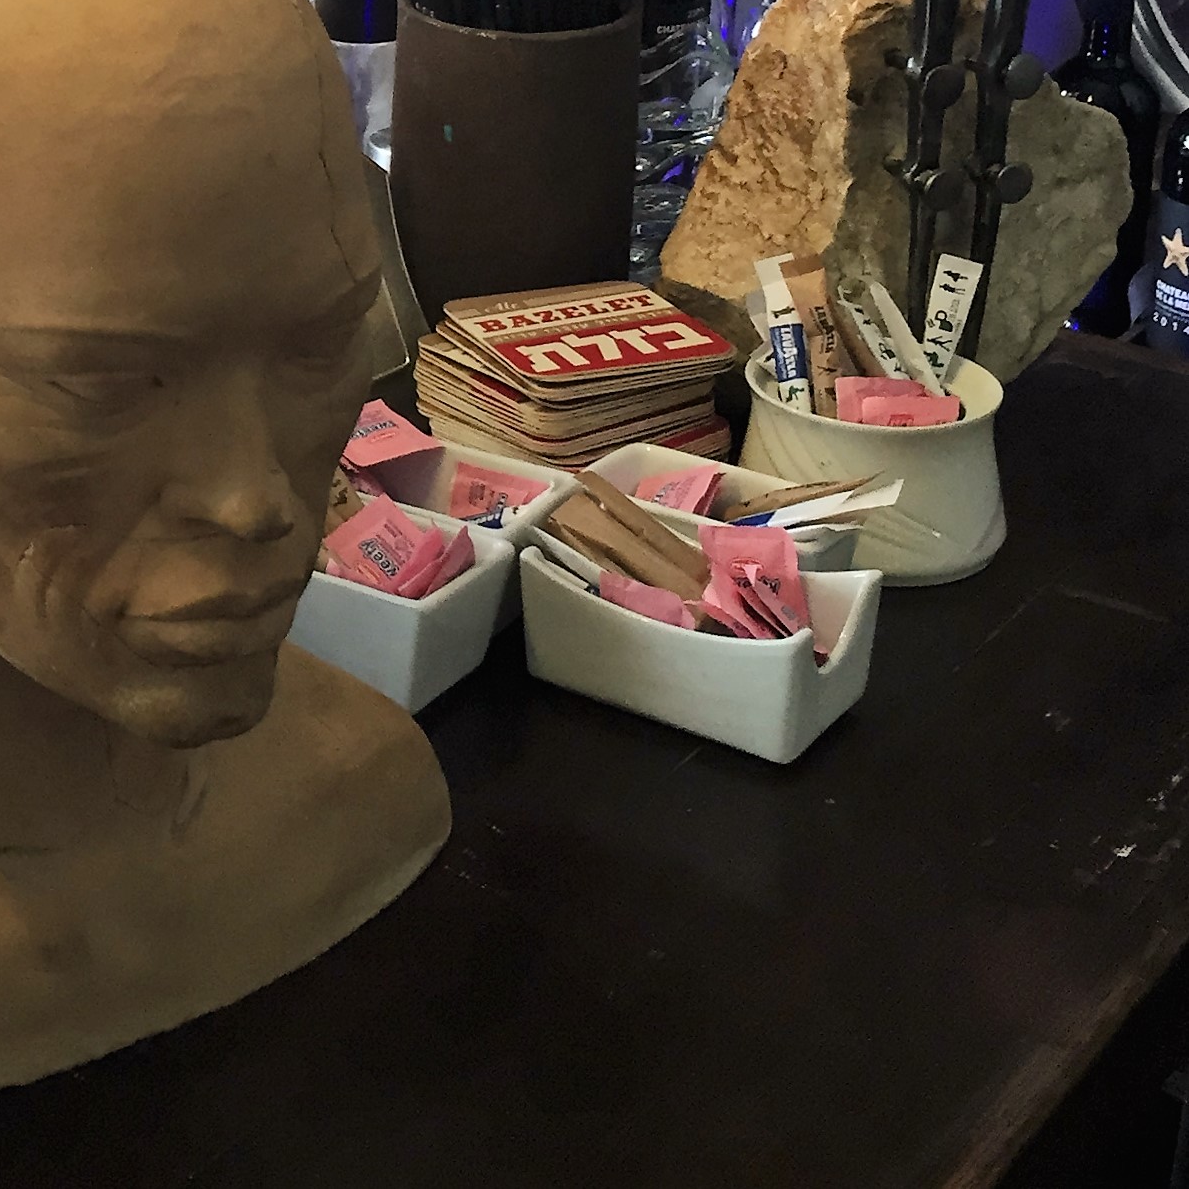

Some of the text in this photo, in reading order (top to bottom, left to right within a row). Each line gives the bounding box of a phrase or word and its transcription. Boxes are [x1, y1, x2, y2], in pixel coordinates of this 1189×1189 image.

[475, 294, 655, 333] BAZELET
[515, 321, 714, 373] בזלת
[780, 326, 798, 379] LAVAZZA
